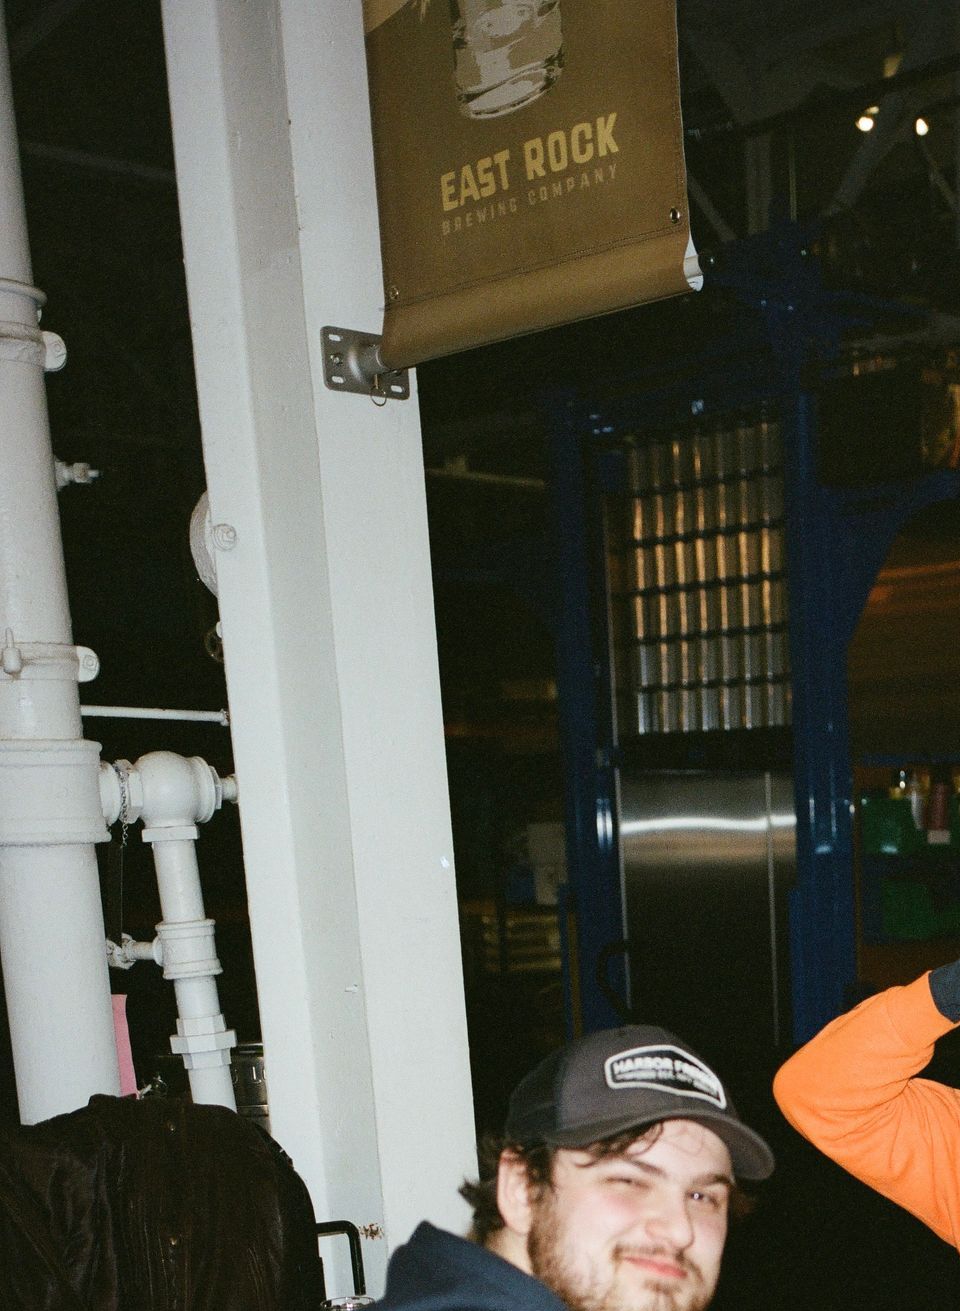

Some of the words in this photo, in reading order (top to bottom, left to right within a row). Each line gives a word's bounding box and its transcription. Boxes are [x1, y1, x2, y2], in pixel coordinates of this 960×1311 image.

[440, 149, 511, 213] EAST
[524, 113, 620, 181] ROCK
[442, 198, 518, 236] BREWING
[528, 163, 619, 206] COMPANY
